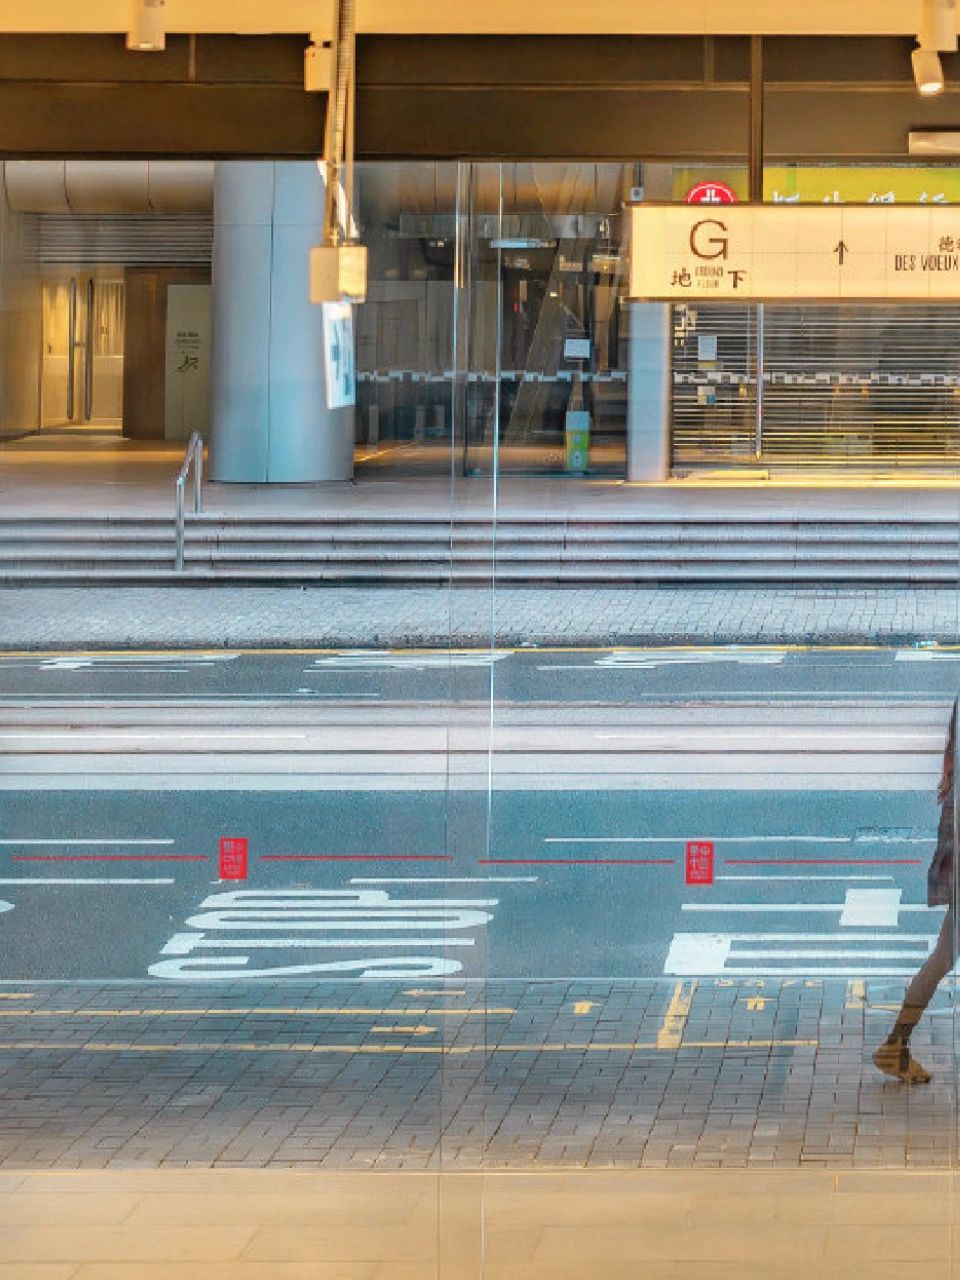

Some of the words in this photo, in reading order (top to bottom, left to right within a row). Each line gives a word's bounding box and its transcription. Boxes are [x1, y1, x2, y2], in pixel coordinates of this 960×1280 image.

[689, 219, 729, 260] G
[894, 254, 917, 271] DES
[920, 254, 959, 271] VOEUX
[671, 267, 692, 288] 地
[728, 270, 748, 289] 下
